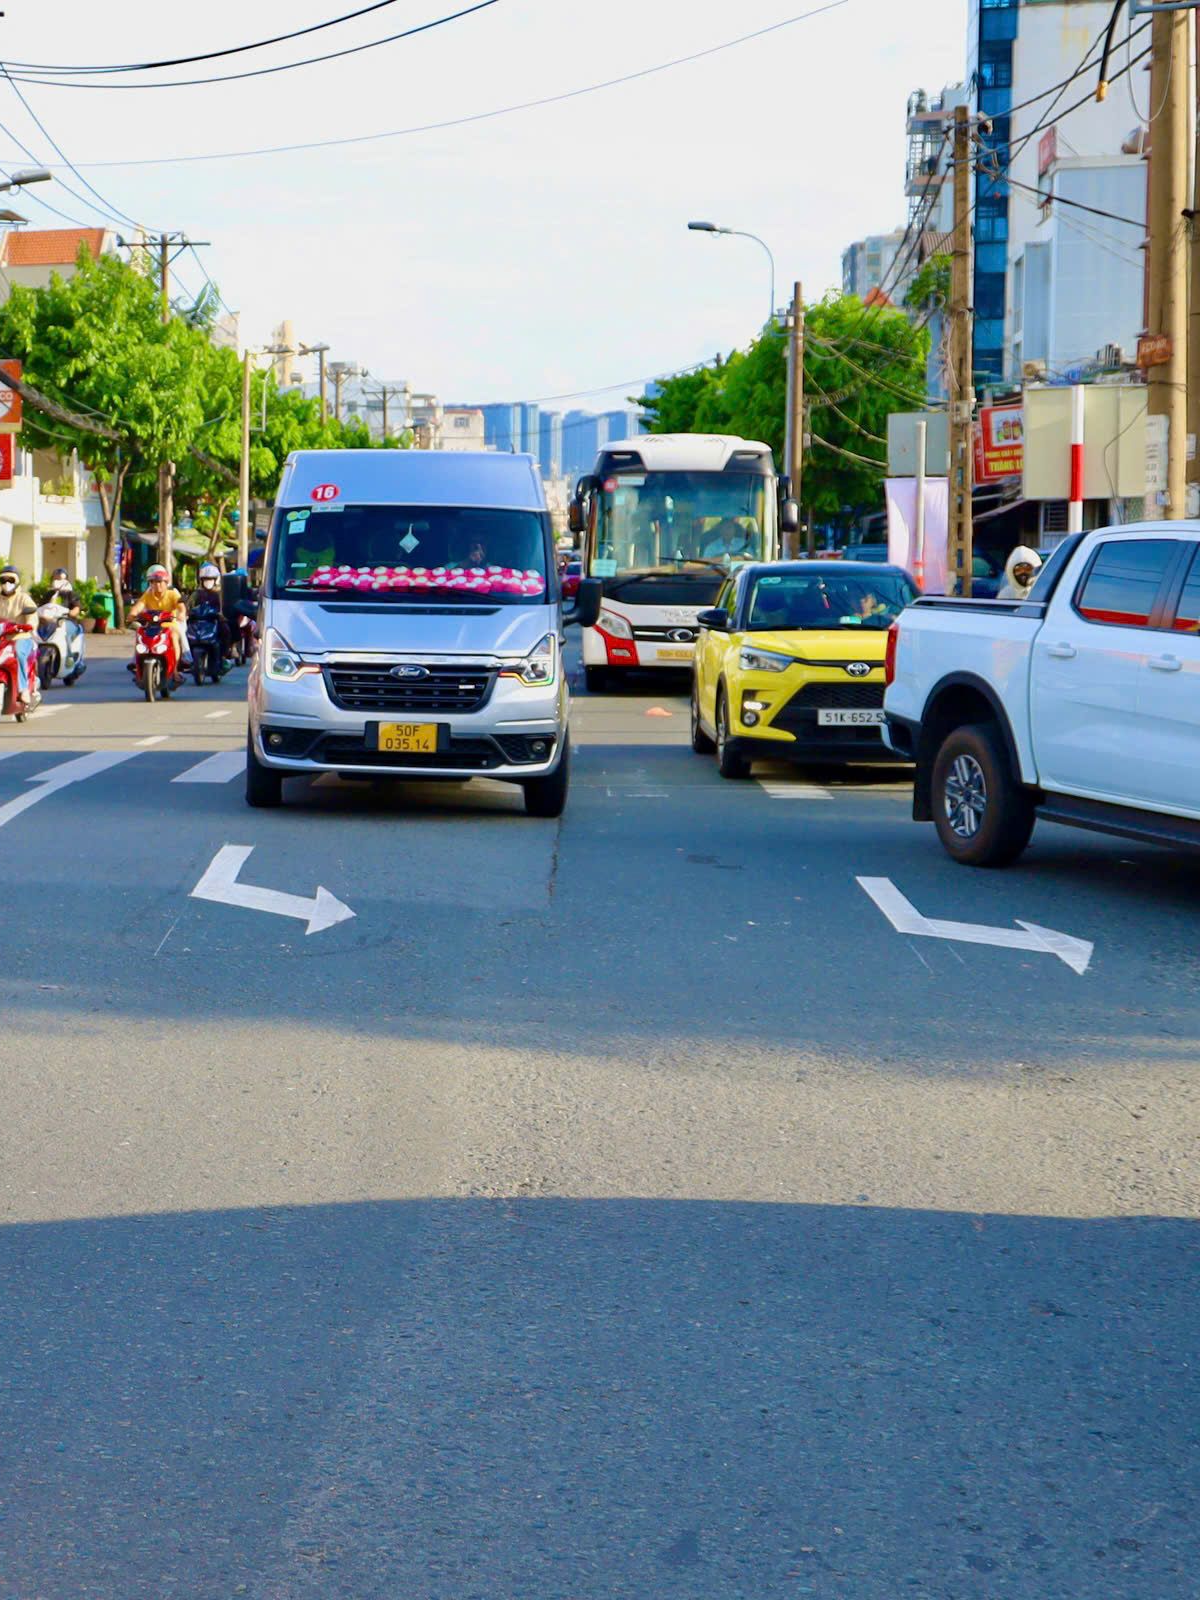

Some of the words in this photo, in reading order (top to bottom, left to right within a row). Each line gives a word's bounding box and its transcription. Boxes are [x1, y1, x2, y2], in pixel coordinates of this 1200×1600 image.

[316, 486, 335, 499] 16
[398, 667, 420, 677] Ford
[396, 725, 420, 737] 50F
[385, 738, 430, 750] 035.14
